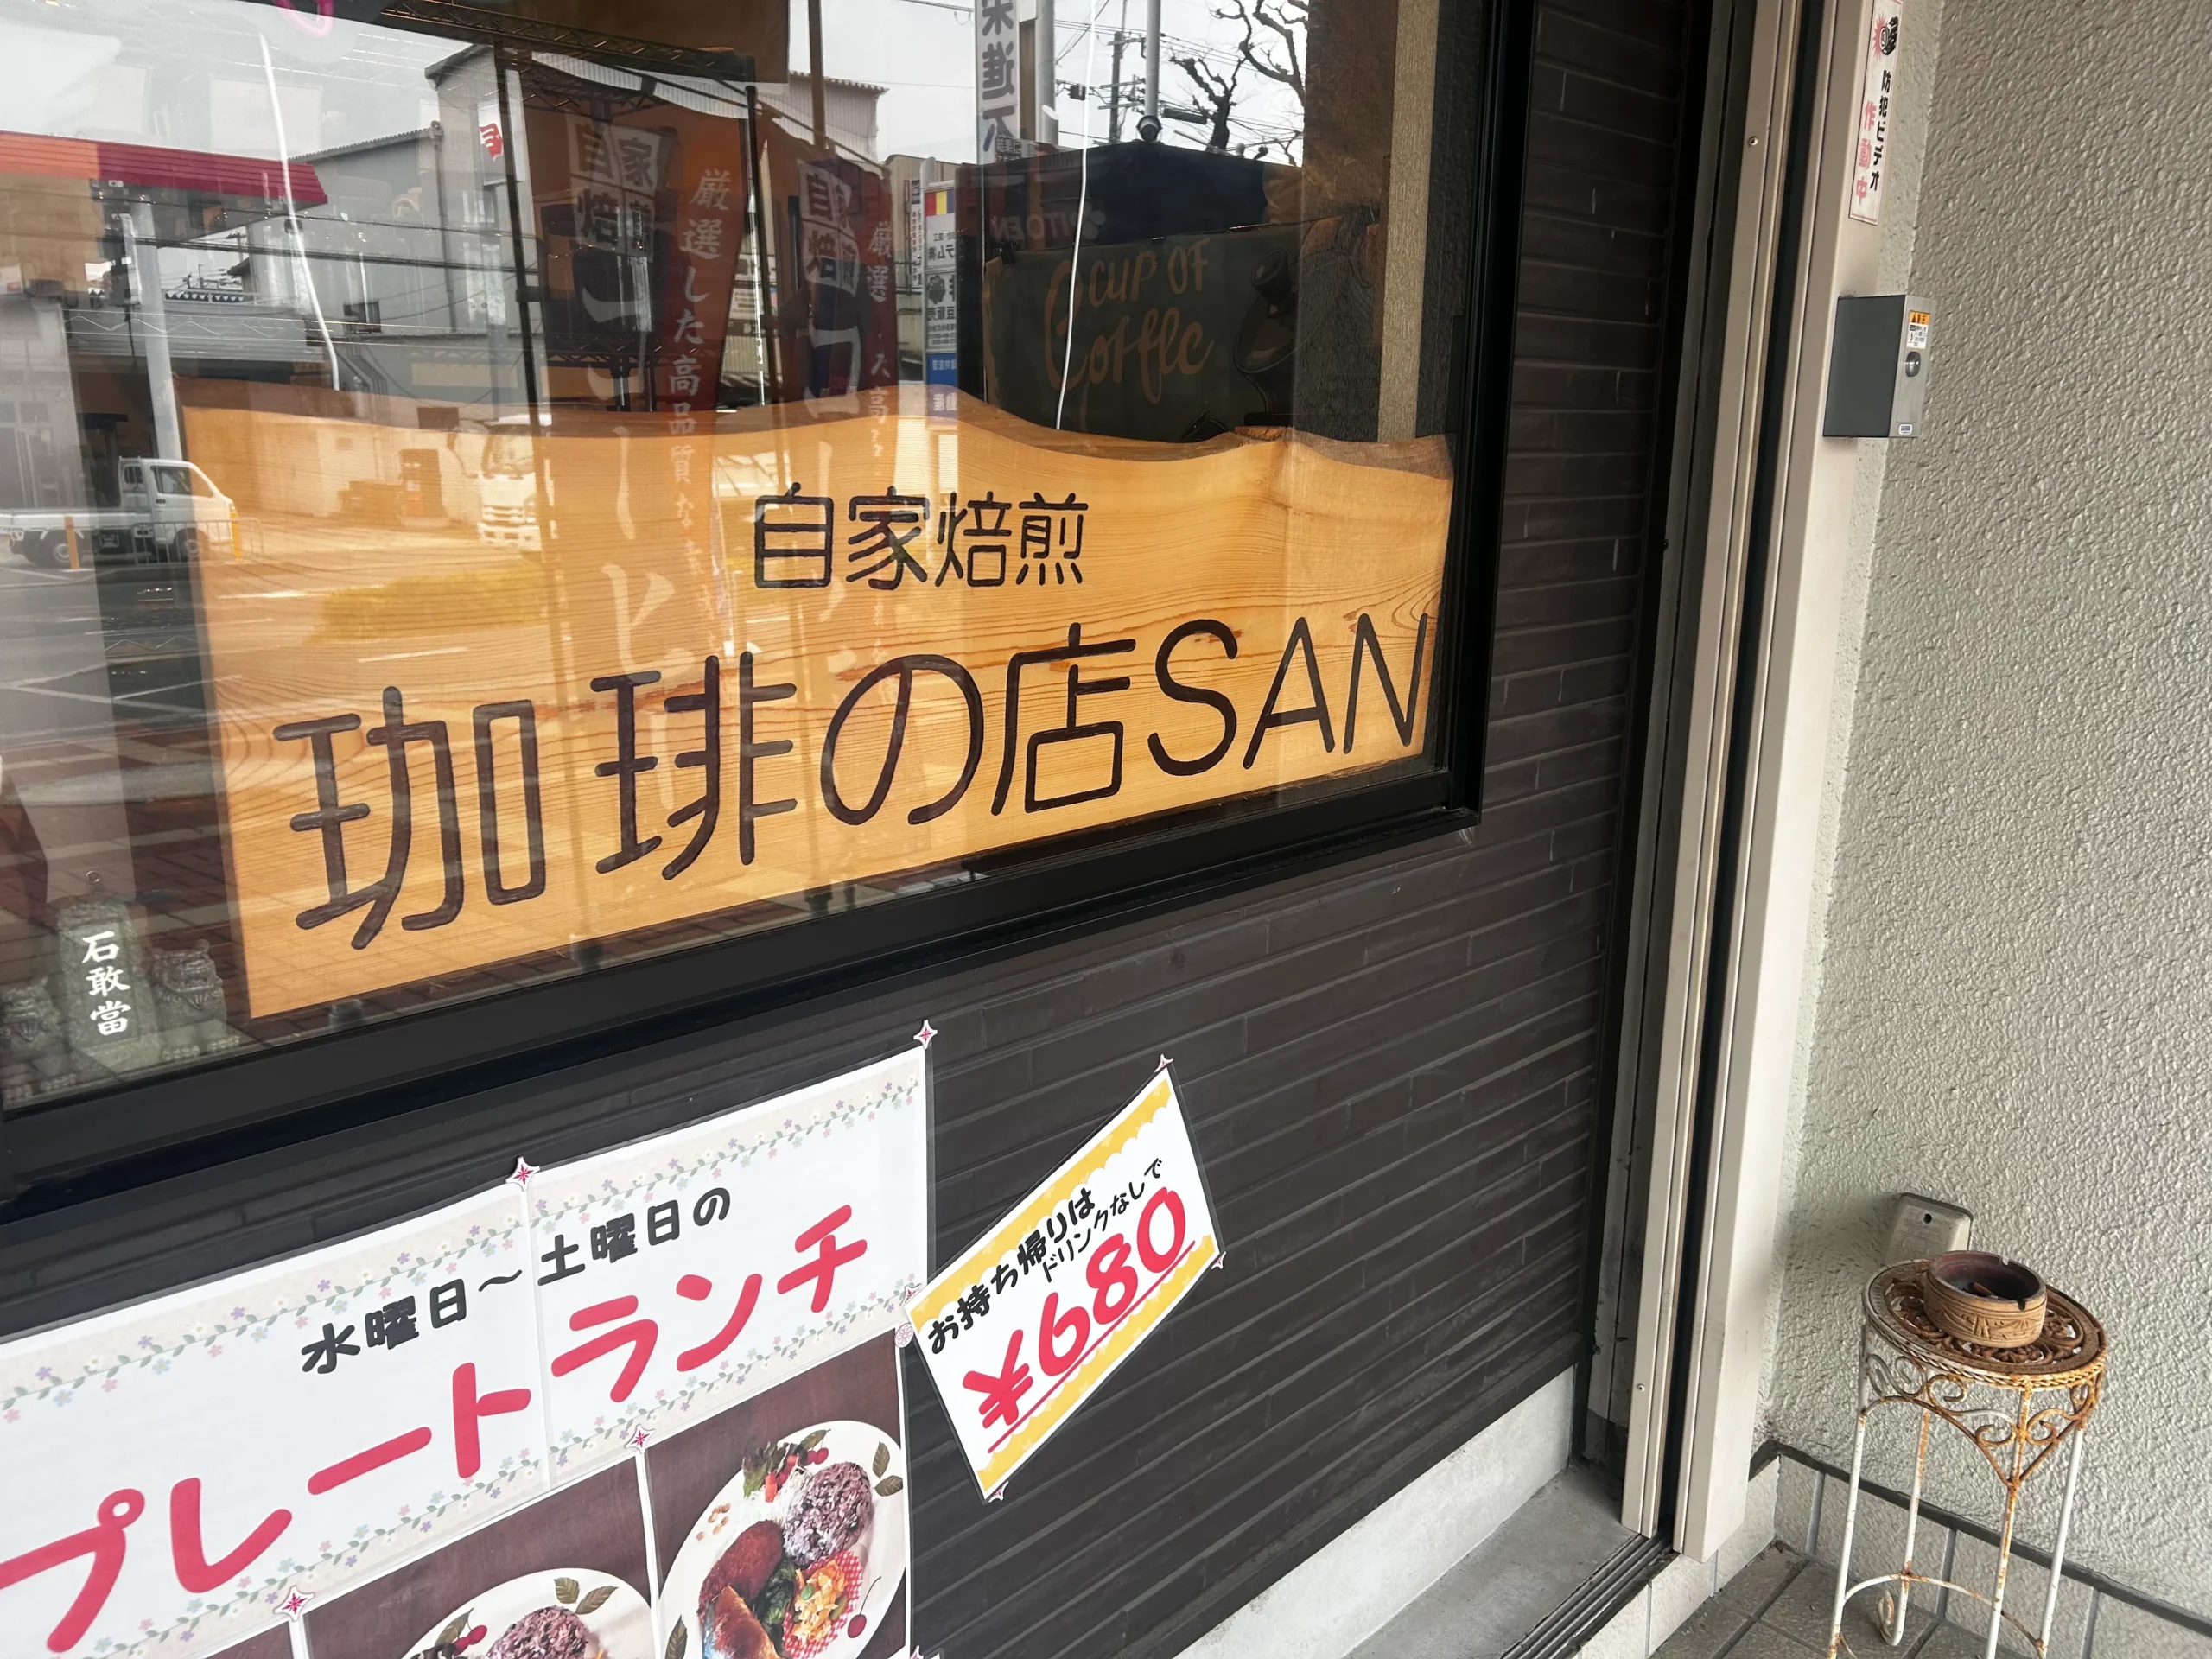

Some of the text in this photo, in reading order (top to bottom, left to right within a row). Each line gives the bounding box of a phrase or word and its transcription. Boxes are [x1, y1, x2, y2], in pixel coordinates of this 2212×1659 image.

[1855, 100, 1876, 206] 作動中
[1870, 69, 1892, 192] 防犯ビデオ
[1167, 238, 1211, 296] OF
[754, 482, 1089, 590] 自家焙煎
[273, 612, 1431, 950] 珈琲の店SAN
[82, 930, 130, 1037] 石敢當
[927, 1186, 1096, 1356] お持ち帰りは
[1042, 1156, 1165, 1284] ドリンクなしで
[962, 1186, 1186, 1429] ¥680
[0, 1203, 868, 1654] プレートランチ
